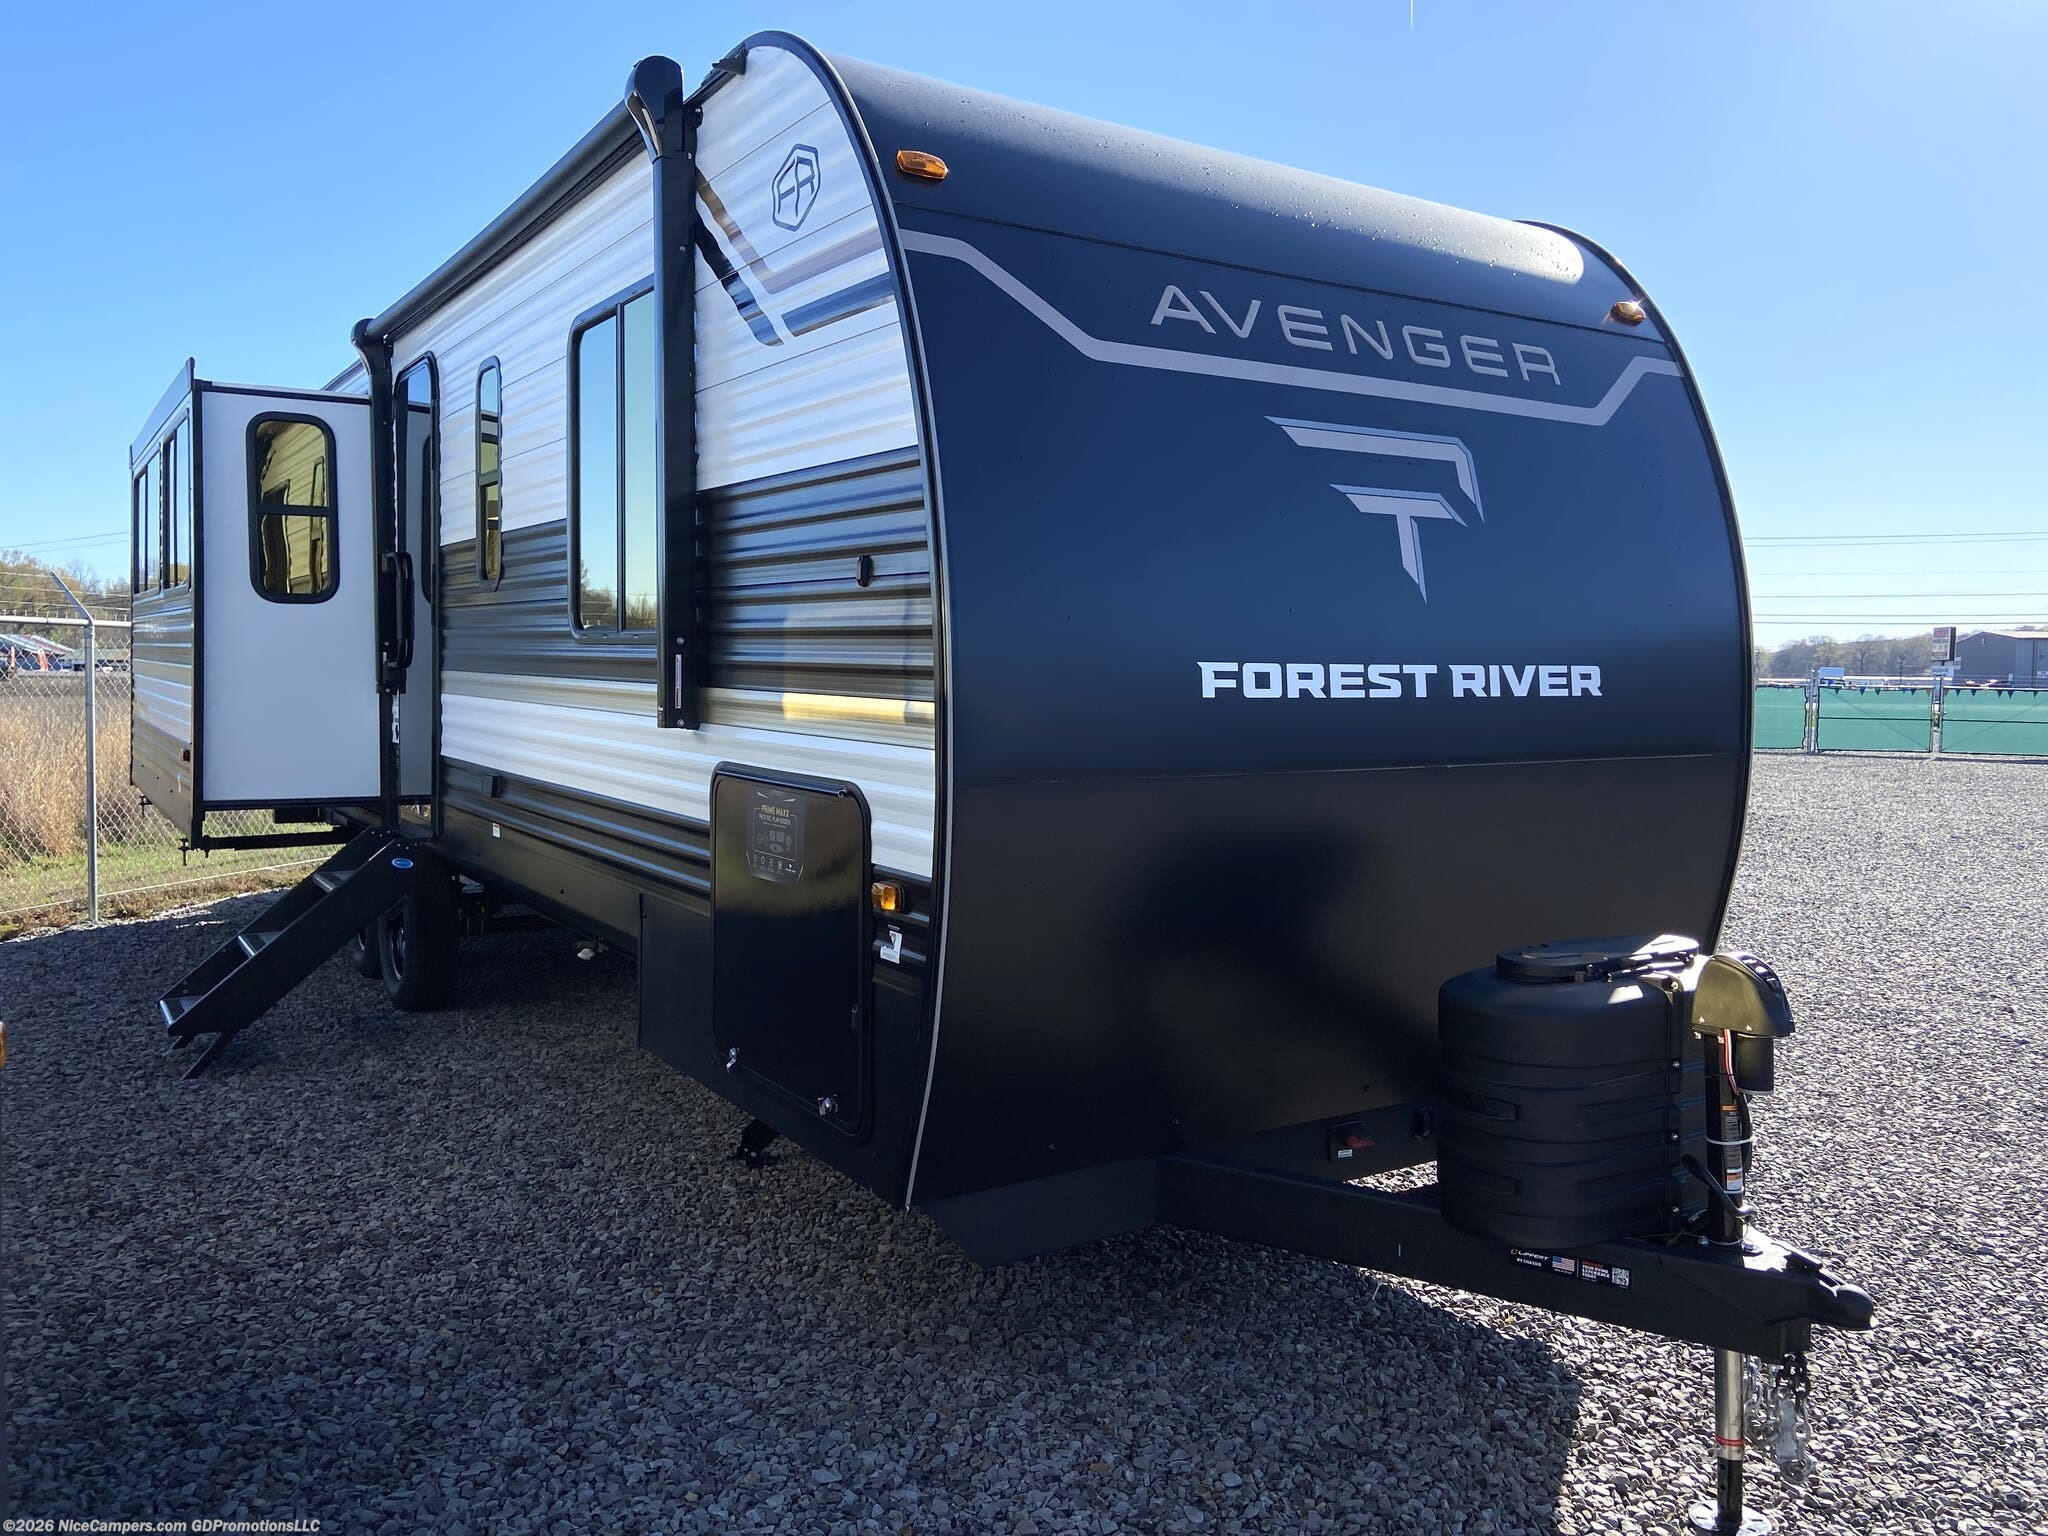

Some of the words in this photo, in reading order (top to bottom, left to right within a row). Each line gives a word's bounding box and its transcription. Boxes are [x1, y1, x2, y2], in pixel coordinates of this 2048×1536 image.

[1149, 284, 1562, 387] AVENGER
[1196, 661, 1439, 699] FOREST
[1447, 663, 1604, 698] RIVER
